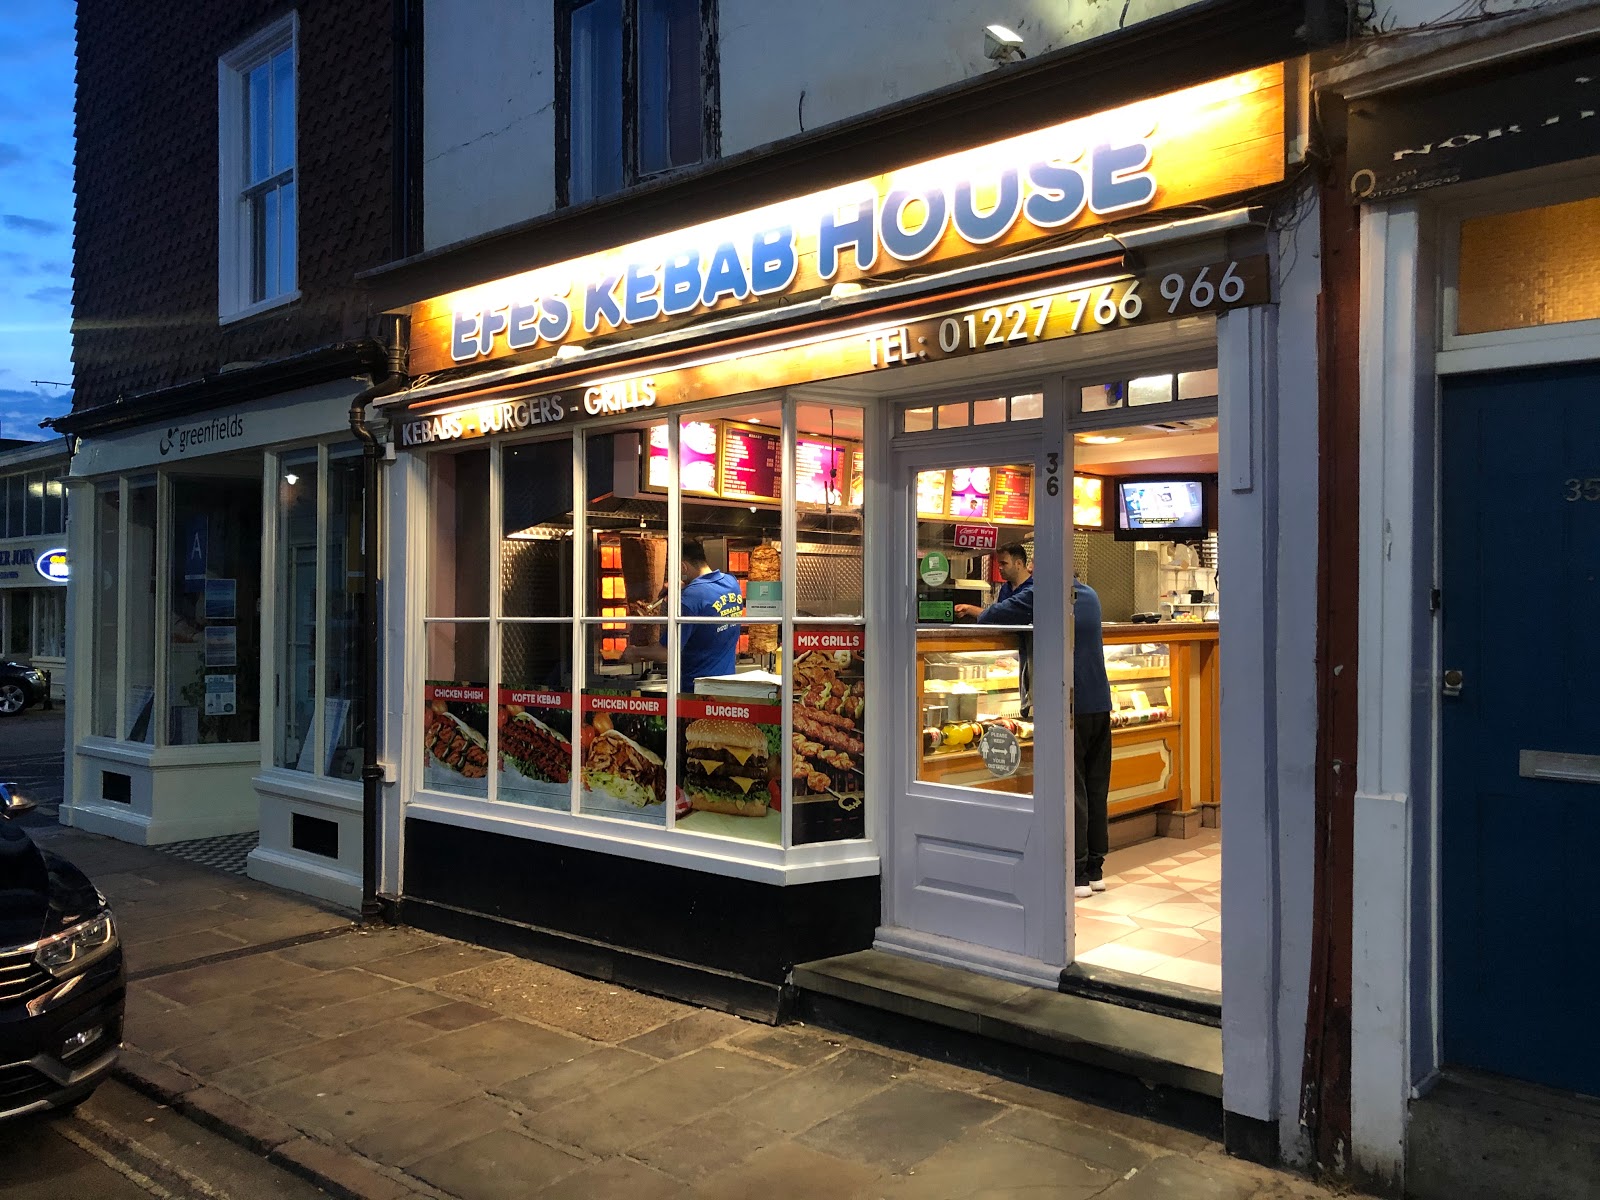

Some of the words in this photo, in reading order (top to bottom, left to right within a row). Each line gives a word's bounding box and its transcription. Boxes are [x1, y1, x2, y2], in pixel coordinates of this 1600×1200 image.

[451, 285, 573, 362] EFES
[583, 222, 799, 334] KEBAB
[817, 125, 1158, 280] HOUSE
[938, 299, 1052, 354] 01227
[1067, 280, 1143, 332] 766
[1159, 261, 1246, 314] 966
[402, 412, 462, 447] KEBABS
[480, 394, 564, 435] BURGERS
[583, 378, 656, 416] GRILLS
[179, 413, 243, 453] greenfields
[1563, 478, 1600, 501] 35
[958, 534, 993, 547] OPEN
[712, 592, 743, 613] EFES
[798, 635, 819, 647] MIX
[821, 635, 860, 647] GRILLS
[434, 688, 463, 700] CHICKEN
[463, 689, 484, 700] SHISH
[512, 693, 535, 704] KOFTE
[536, 694, 561, 706] KEBAB
[591, 698, 628, 710] CHICKEN
[629, 700, 659, 712] DONER
[705, 704, 750, 718] BURGERS
